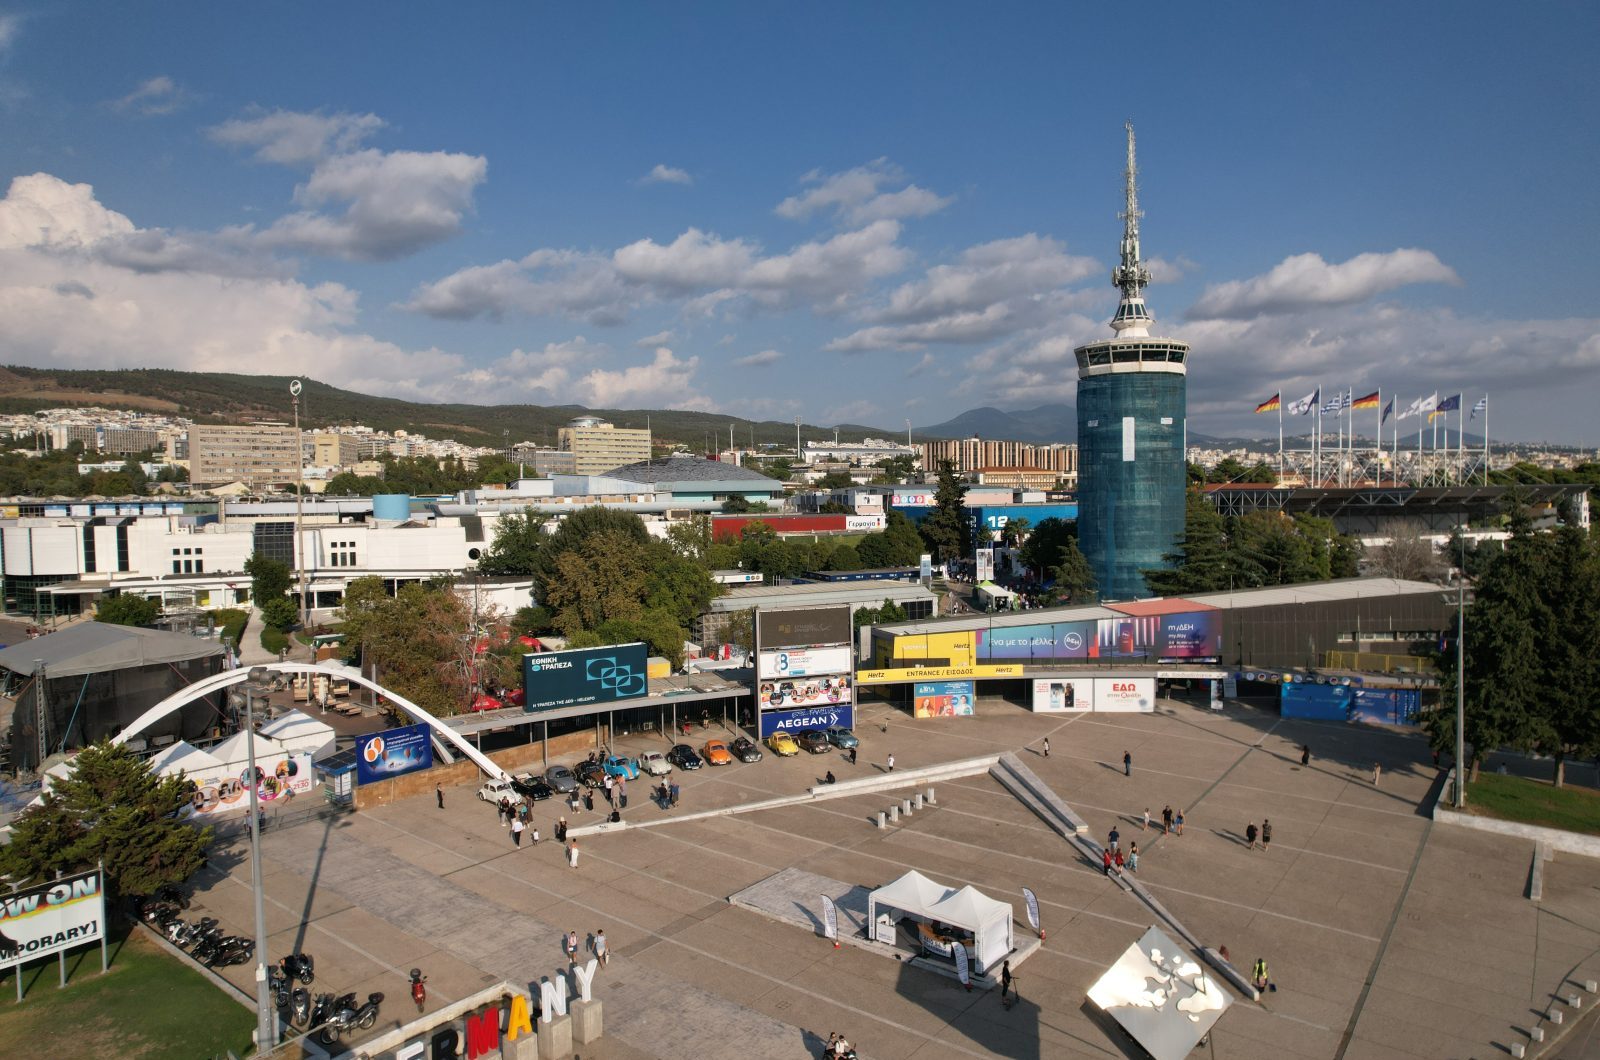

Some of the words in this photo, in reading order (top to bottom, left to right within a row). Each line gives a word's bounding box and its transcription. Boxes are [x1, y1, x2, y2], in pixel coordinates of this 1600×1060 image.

[987, 516, 1008, 528] 12
[1006, 640, 1016, 648] με
[532, 656, 558, 666] ΕΘΝΙΚΗ
[541, 661, 572, 670] ΤΡΑΠΕΖΑ
[1112, 683, 1136, 692] ΕΔΩ
[776, 716, 827, 728] AEGEAN
[46, 876, 96, 905] ON
